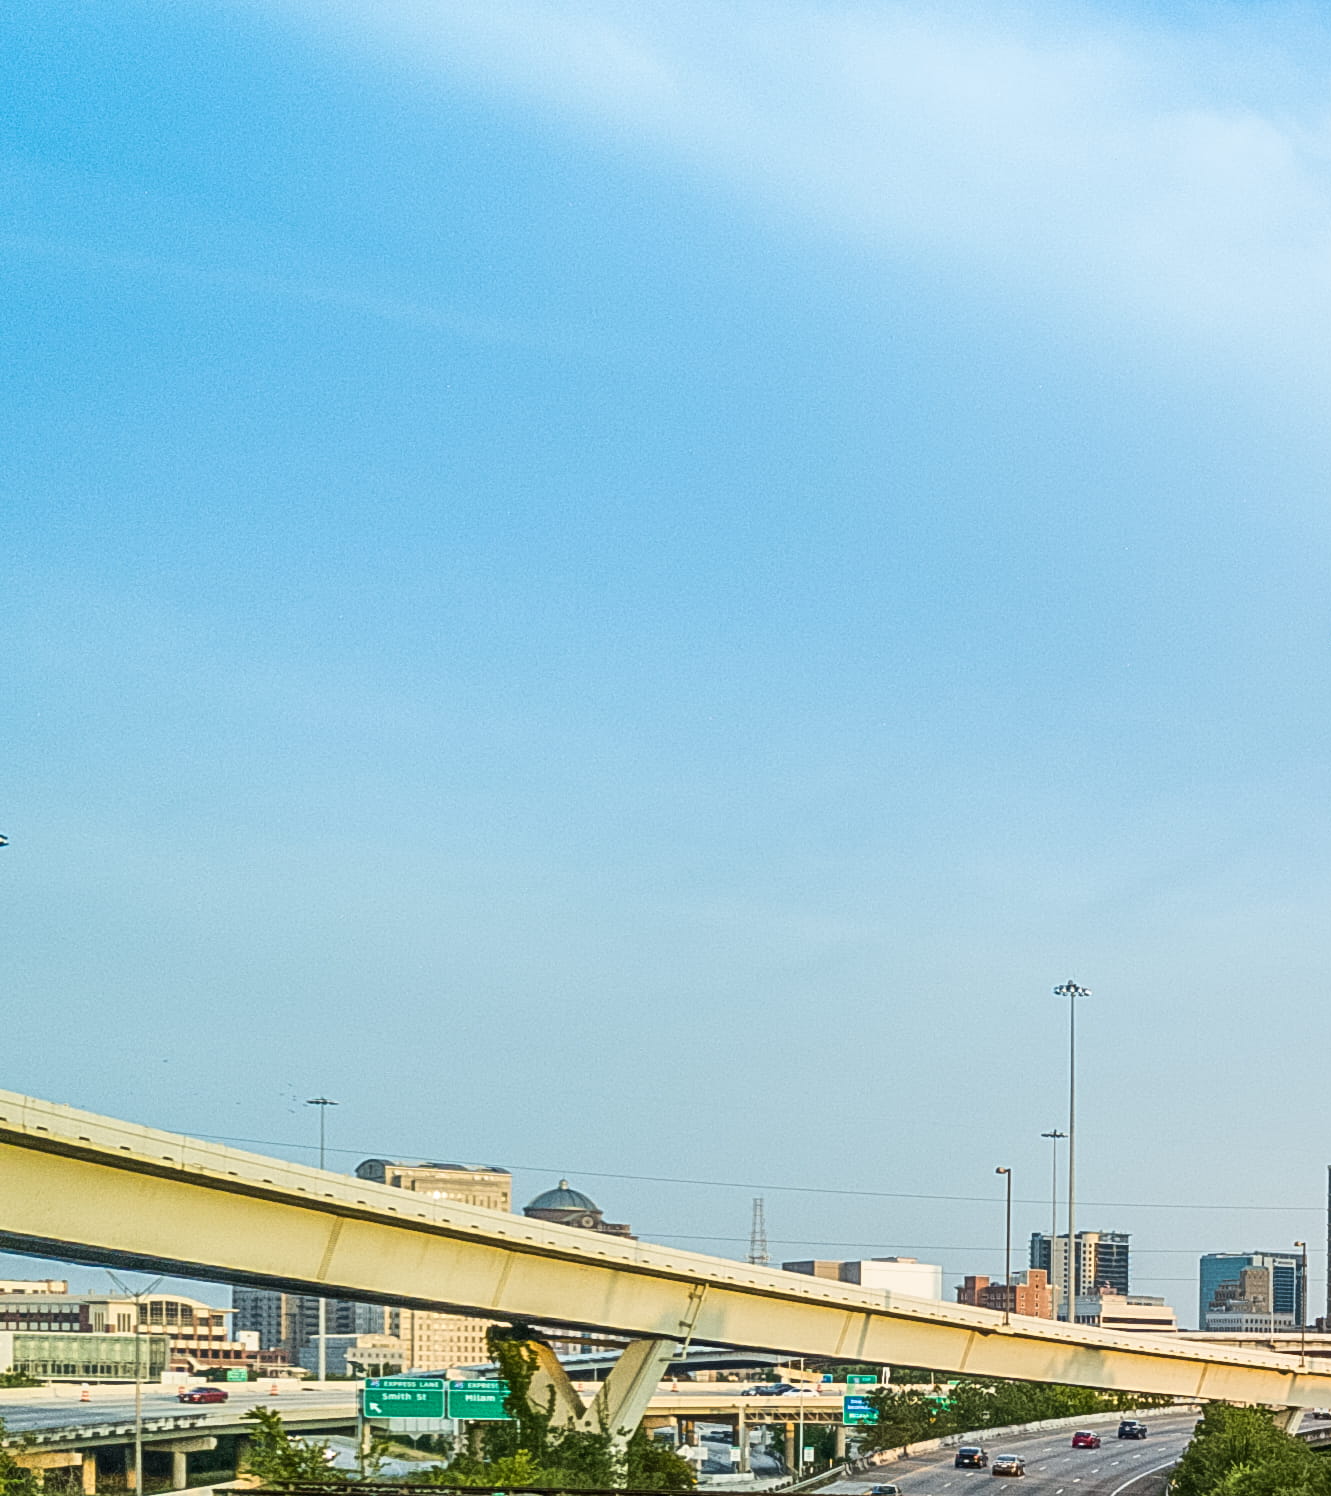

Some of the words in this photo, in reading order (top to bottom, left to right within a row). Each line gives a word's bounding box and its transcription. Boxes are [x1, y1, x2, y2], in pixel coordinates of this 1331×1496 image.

[382, 1392, 411, 1401] Smith
[416, 1393, 427, 1401] St
[465, 1394, 495, 1402] Milam
